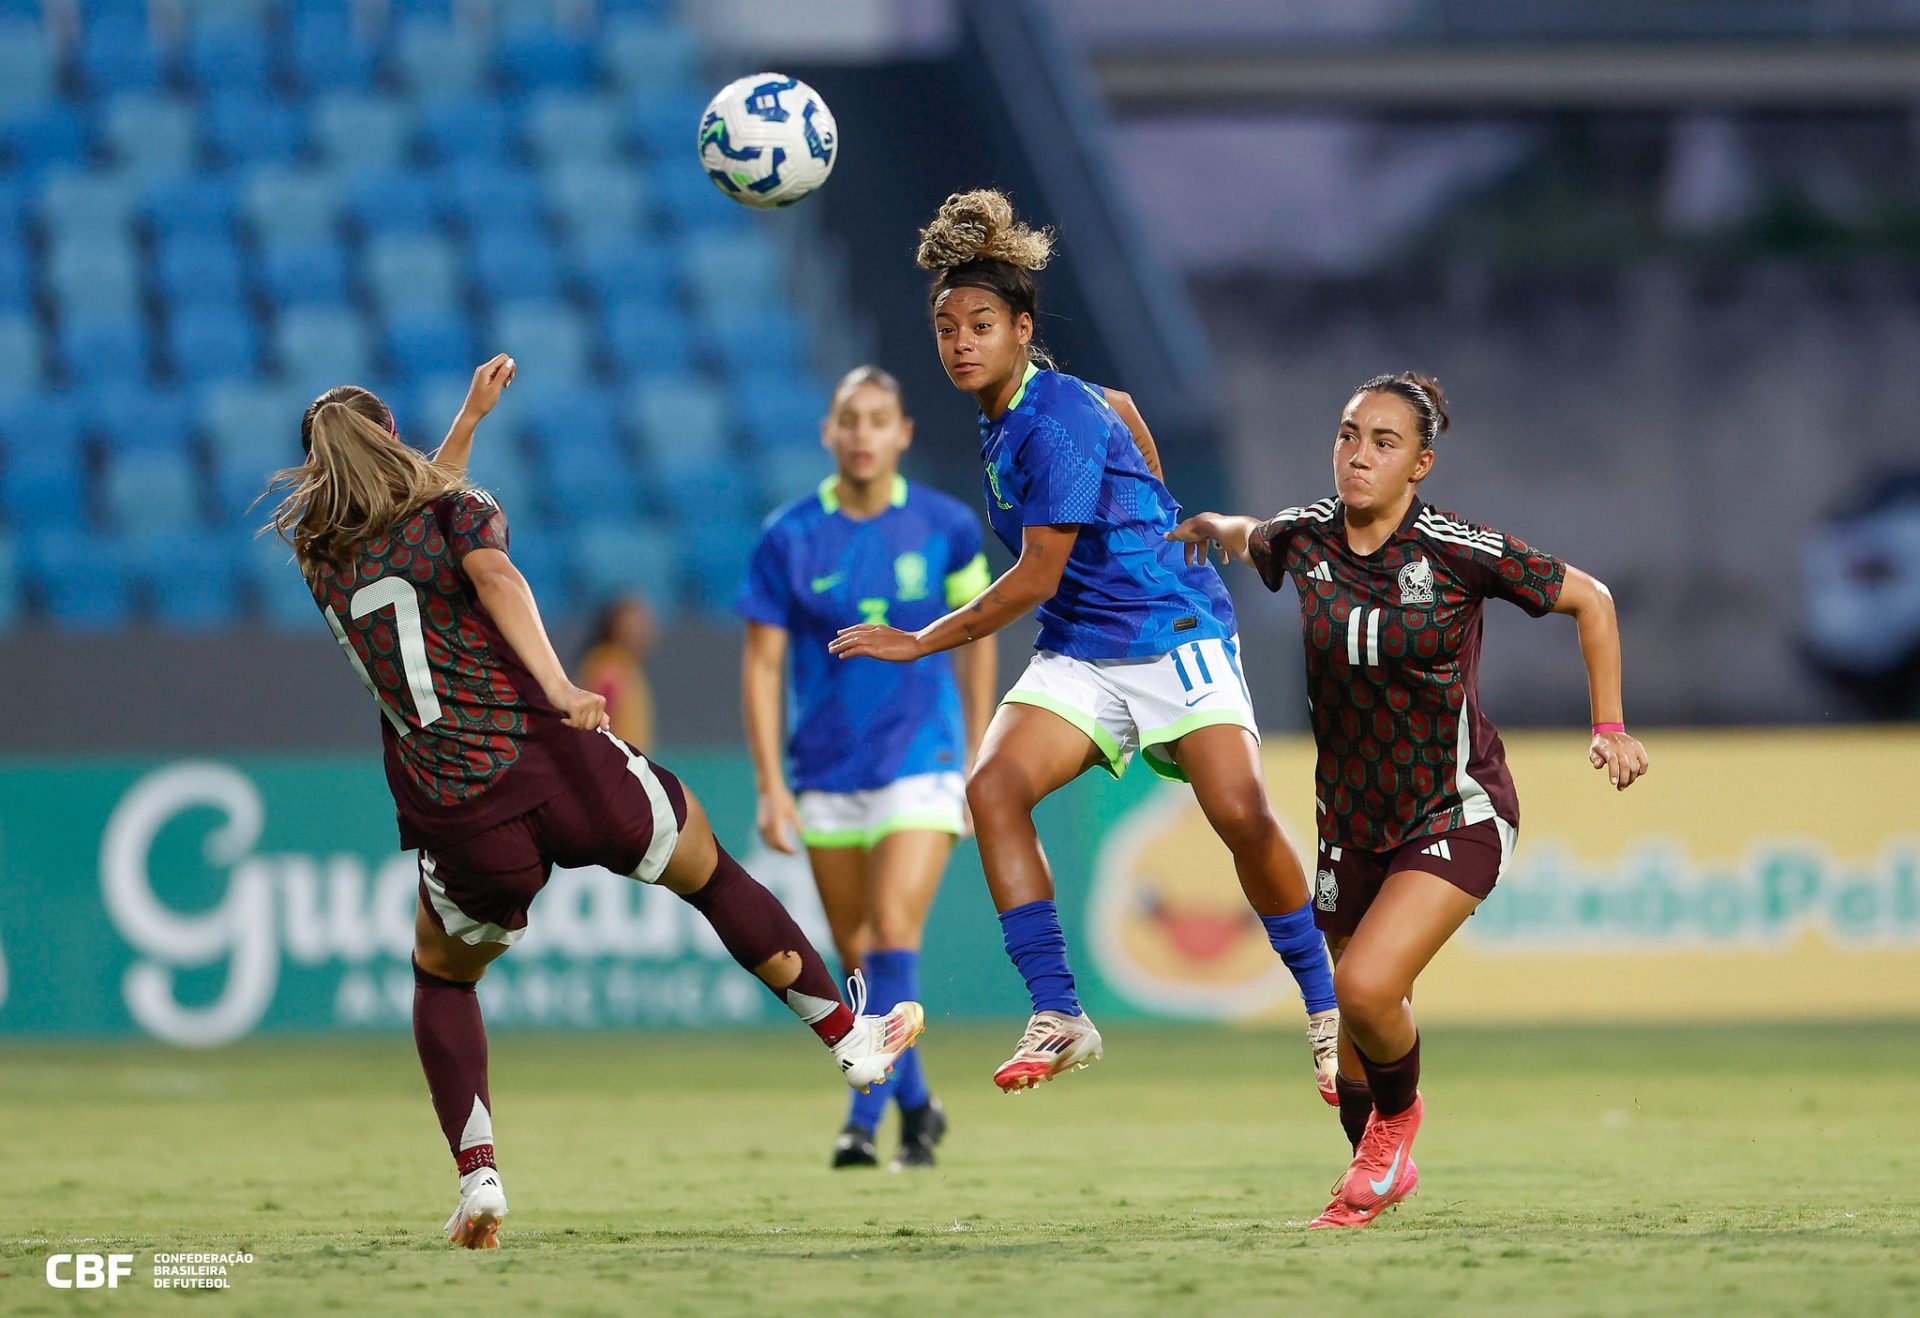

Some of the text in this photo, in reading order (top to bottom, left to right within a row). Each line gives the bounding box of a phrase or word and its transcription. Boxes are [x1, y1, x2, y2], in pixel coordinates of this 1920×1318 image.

[324, 575, 443, 738] 17
[1170, 642, 1213, 692] 11
[1347, 606, 1380, 667] 11
